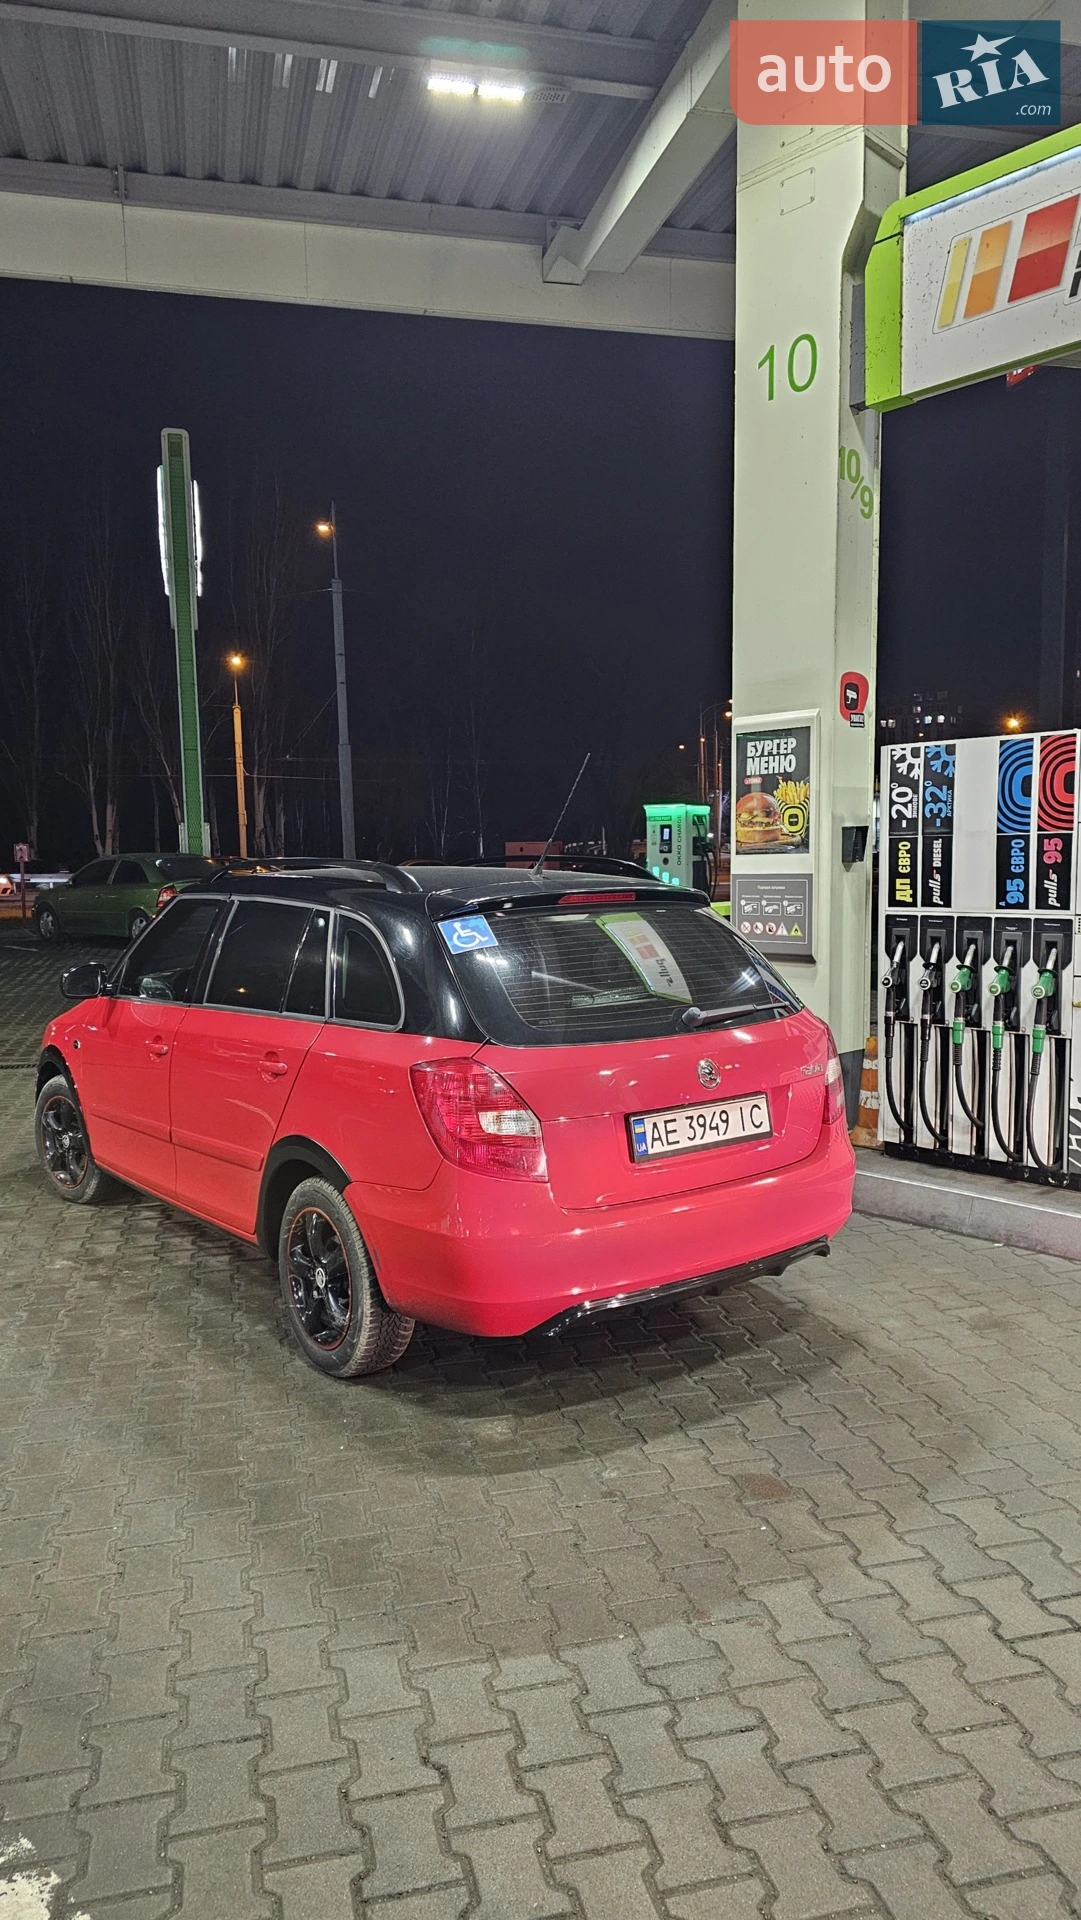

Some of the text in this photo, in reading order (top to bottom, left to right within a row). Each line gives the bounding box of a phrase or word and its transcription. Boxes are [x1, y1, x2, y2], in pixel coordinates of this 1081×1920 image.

[757, 333, 818, 402] 10
[746, 737, 797, 758] БУРГЕР
[746, 754, 797, 776] МЕНЮ
[898, 841, 911, 874] ЄВРО
[932, 838, 943, 868] DIESEL
[1010, 838, 1025, 874] ЄВРО
[1043, 837, 1064, 865] 95
[895, 878, 913, 903] ДП
[928, 869, 944, 905] pulls
[1005, 878, 1025, 905] 95
[1043, 869, 1061, 907] pulls
[650, 1103, 764, 1150] AE 3949 IC
[636, 1144, 647, 1152] UA
